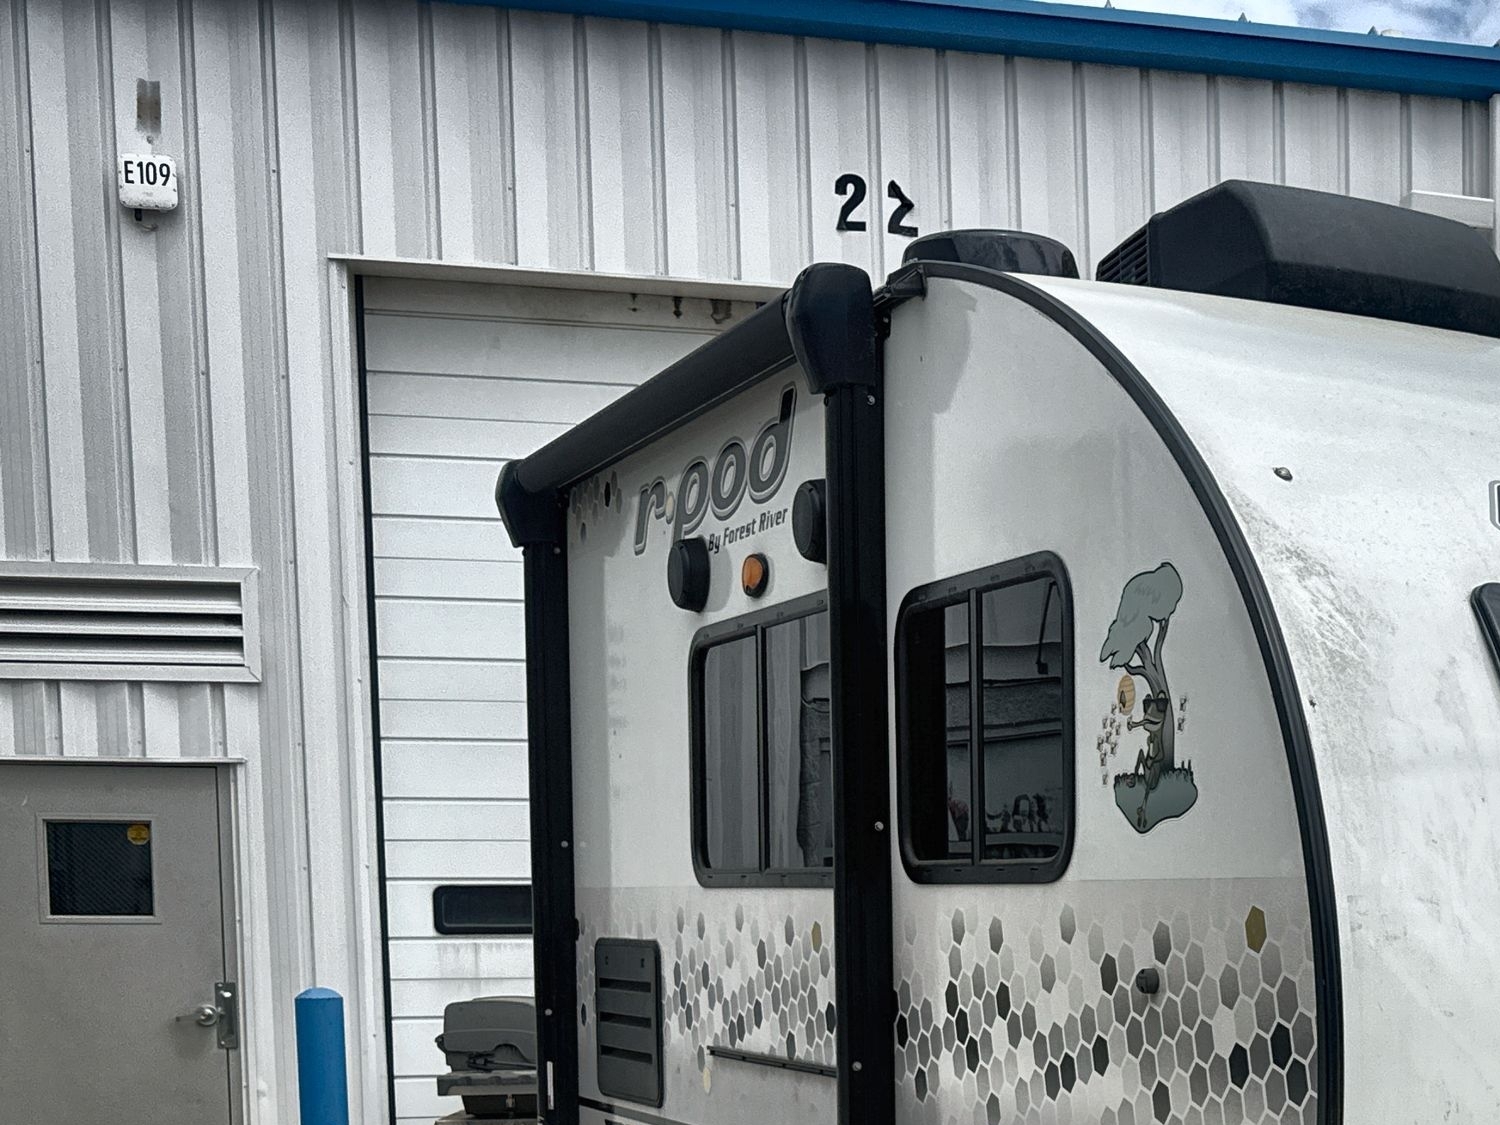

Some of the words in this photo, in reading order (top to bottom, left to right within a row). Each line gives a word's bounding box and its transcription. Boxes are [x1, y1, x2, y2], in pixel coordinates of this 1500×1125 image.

[124, 160, 171, 187] E109
[834, 173, 919, 238] 22
[708, 533, 721, 555] By
[722, 518, 757, 547] Forest
[758, 508, 788, 533] River
